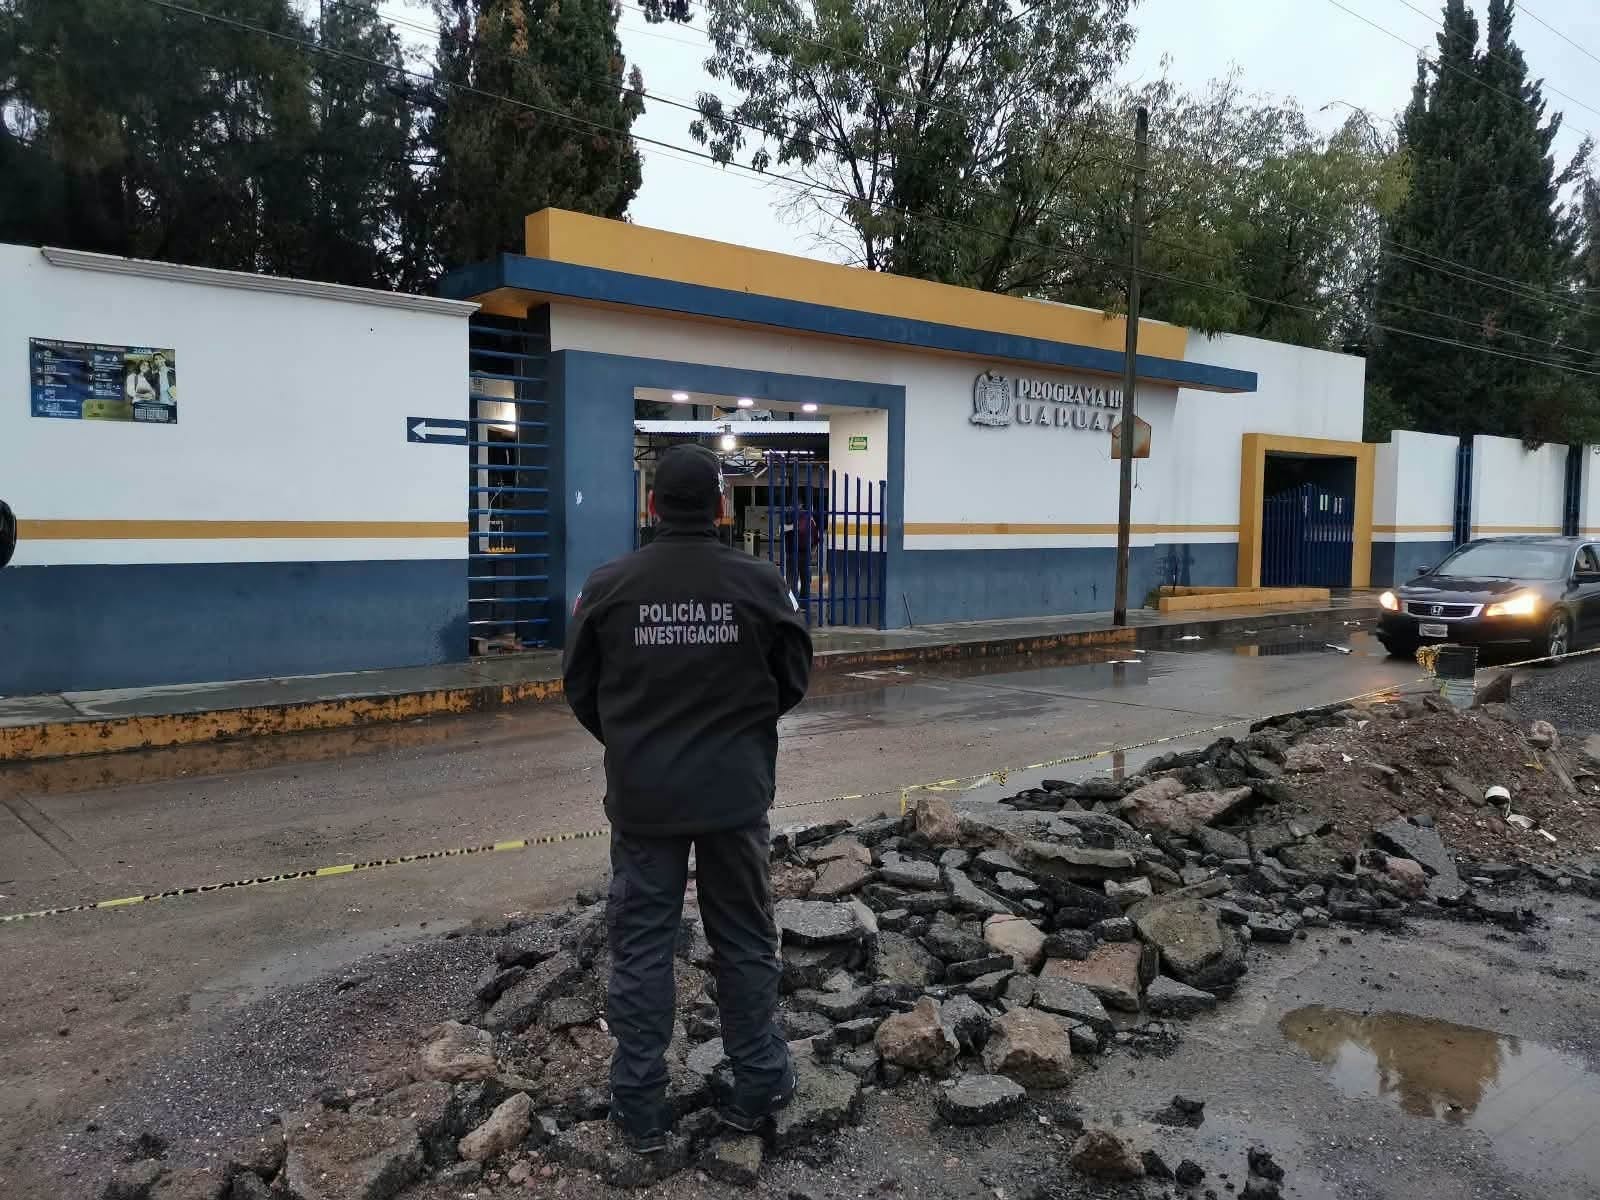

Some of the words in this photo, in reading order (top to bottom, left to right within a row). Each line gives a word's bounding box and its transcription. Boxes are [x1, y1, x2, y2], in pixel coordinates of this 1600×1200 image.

[1016, 377, 1105, 407] PROGRAMA
[639, 599, 706, 622] POLICÍA
[711, 602, 733, 621] DE
[634, 621, 739, 646] INVESTIGACIÓN
